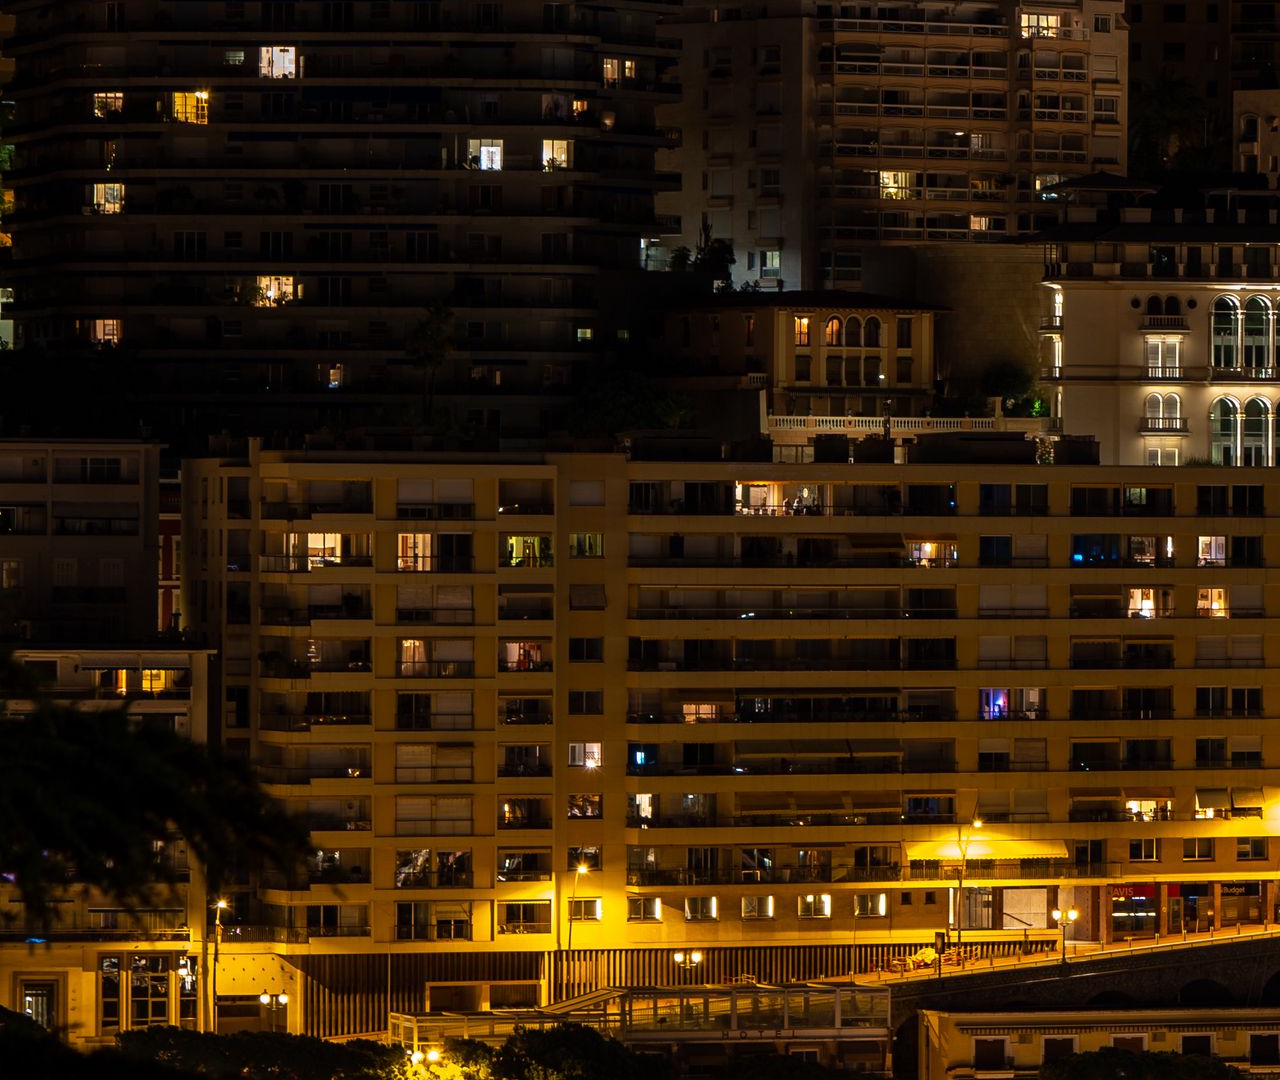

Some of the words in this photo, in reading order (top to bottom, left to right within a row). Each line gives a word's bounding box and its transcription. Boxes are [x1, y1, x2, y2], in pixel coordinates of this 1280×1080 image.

[1113, 887, 1134, 896] AVIS
[1223, 886, 1246, 895] Budget
[721, 1030, 799, 1039] HOTEL
